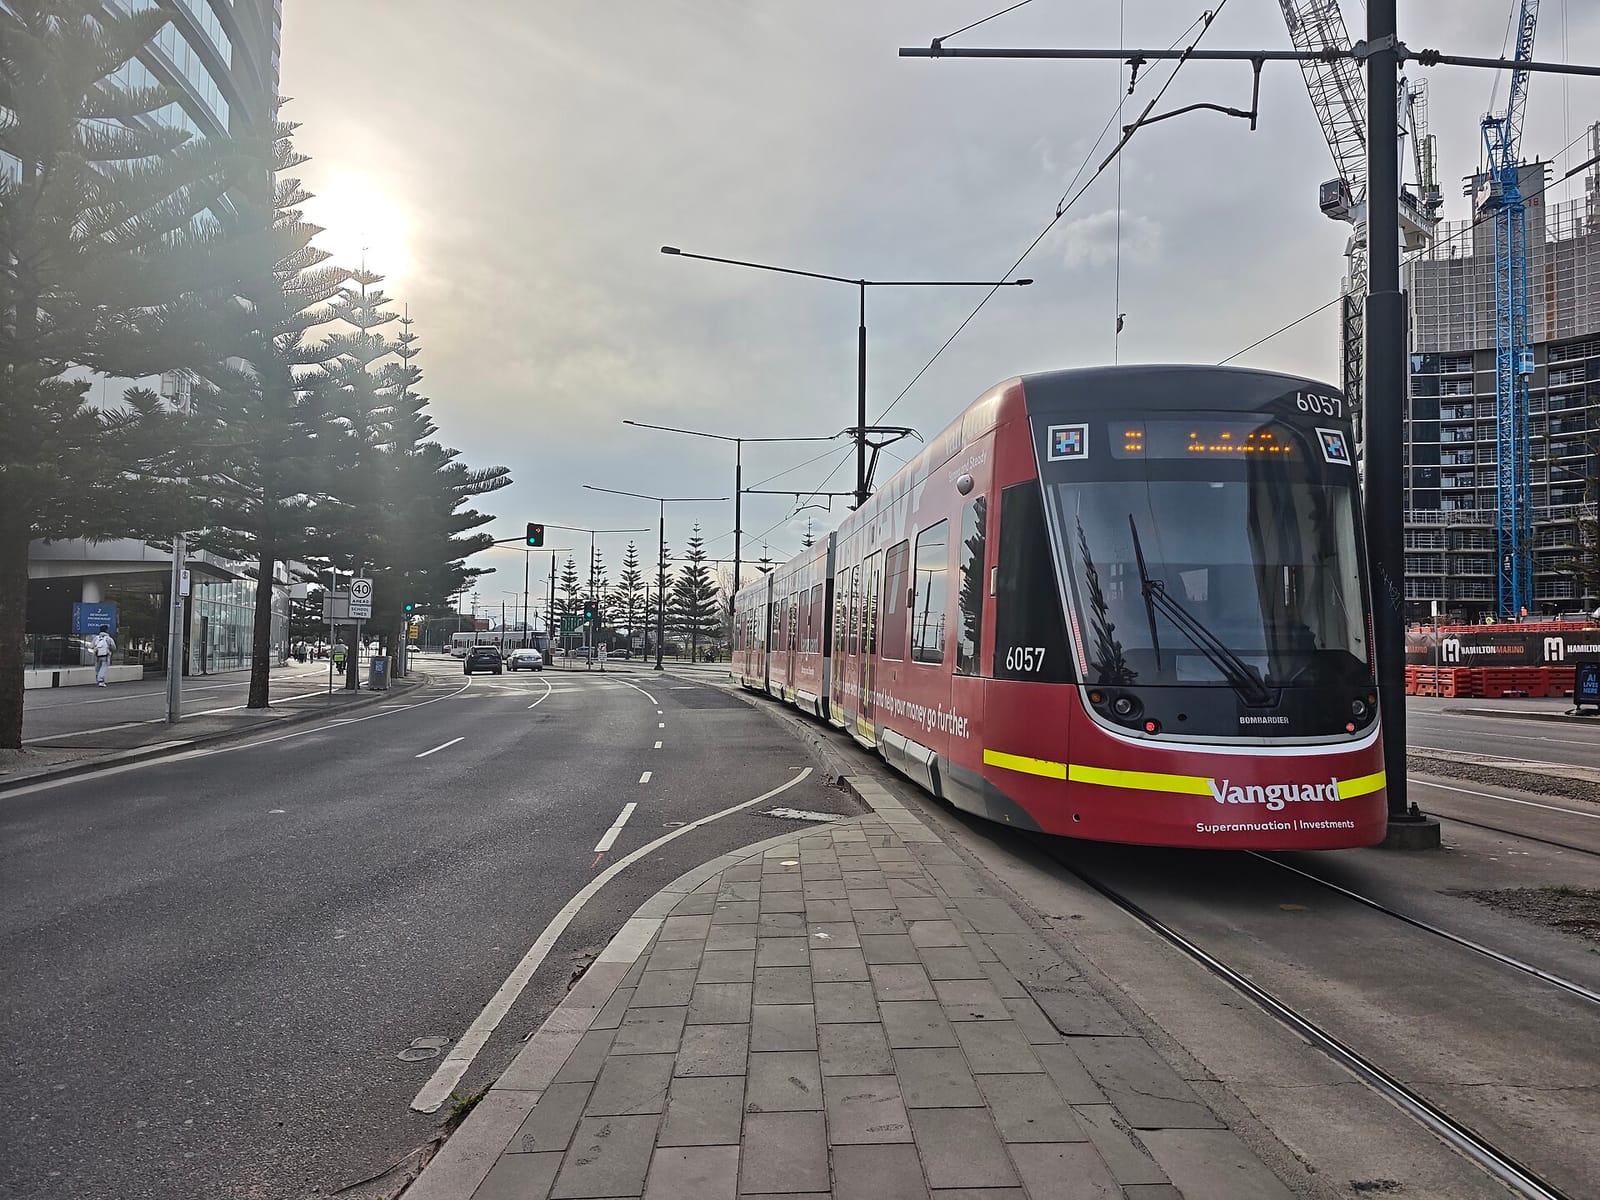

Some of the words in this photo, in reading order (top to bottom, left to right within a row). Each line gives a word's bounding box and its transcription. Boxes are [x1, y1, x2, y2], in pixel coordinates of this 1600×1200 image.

[1296, 392, 1342, 418] 6057
[354, 585, 368, 594] 40
[1006, 646, 1046, 672] 6057
[894, 697, 906, 718] your
[906, 701, 927, 731] money
[927, 708, 937, 733] go
[937, 703, 969, 740] further.
[1239, 716, 1290, 724] BOMBARDIER
[1207, 777, 1341, 811] Vanguard
[1196, 820, 1291, 834] Superannuation
[1300, 820, 1354, 830] Investments
